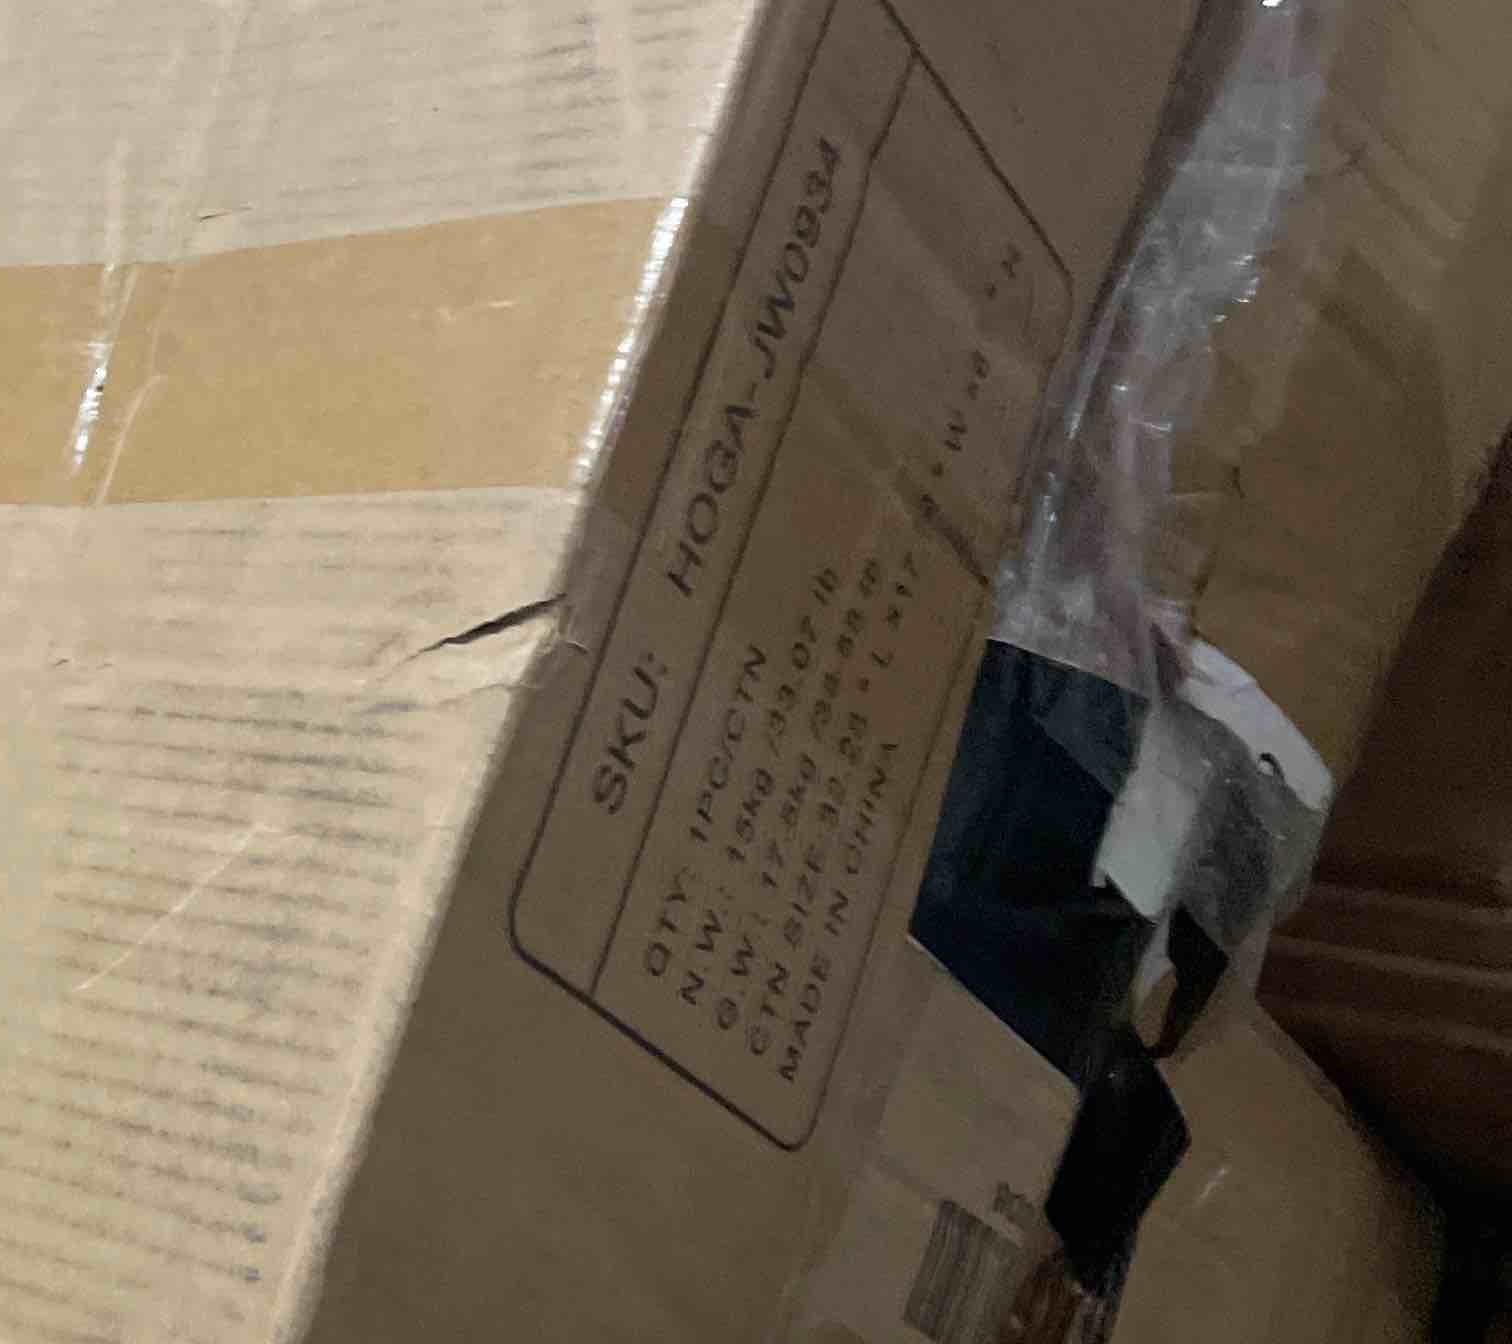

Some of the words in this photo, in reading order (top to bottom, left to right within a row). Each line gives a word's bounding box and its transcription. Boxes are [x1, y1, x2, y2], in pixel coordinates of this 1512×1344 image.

[591, 651, 669, 815] SKU:
[667, 137, 842, 599] HOGA-JW0934
[645, 865, 696, 976] QTY:
[689, 643, 767, 843] 1PC/CTN
[726, 767, 774, 861] 15kg
[747, 961, 790, 1056] CTN
[777, 951, 831, 1083] MADE
[823, 889, 849, 937] IN
